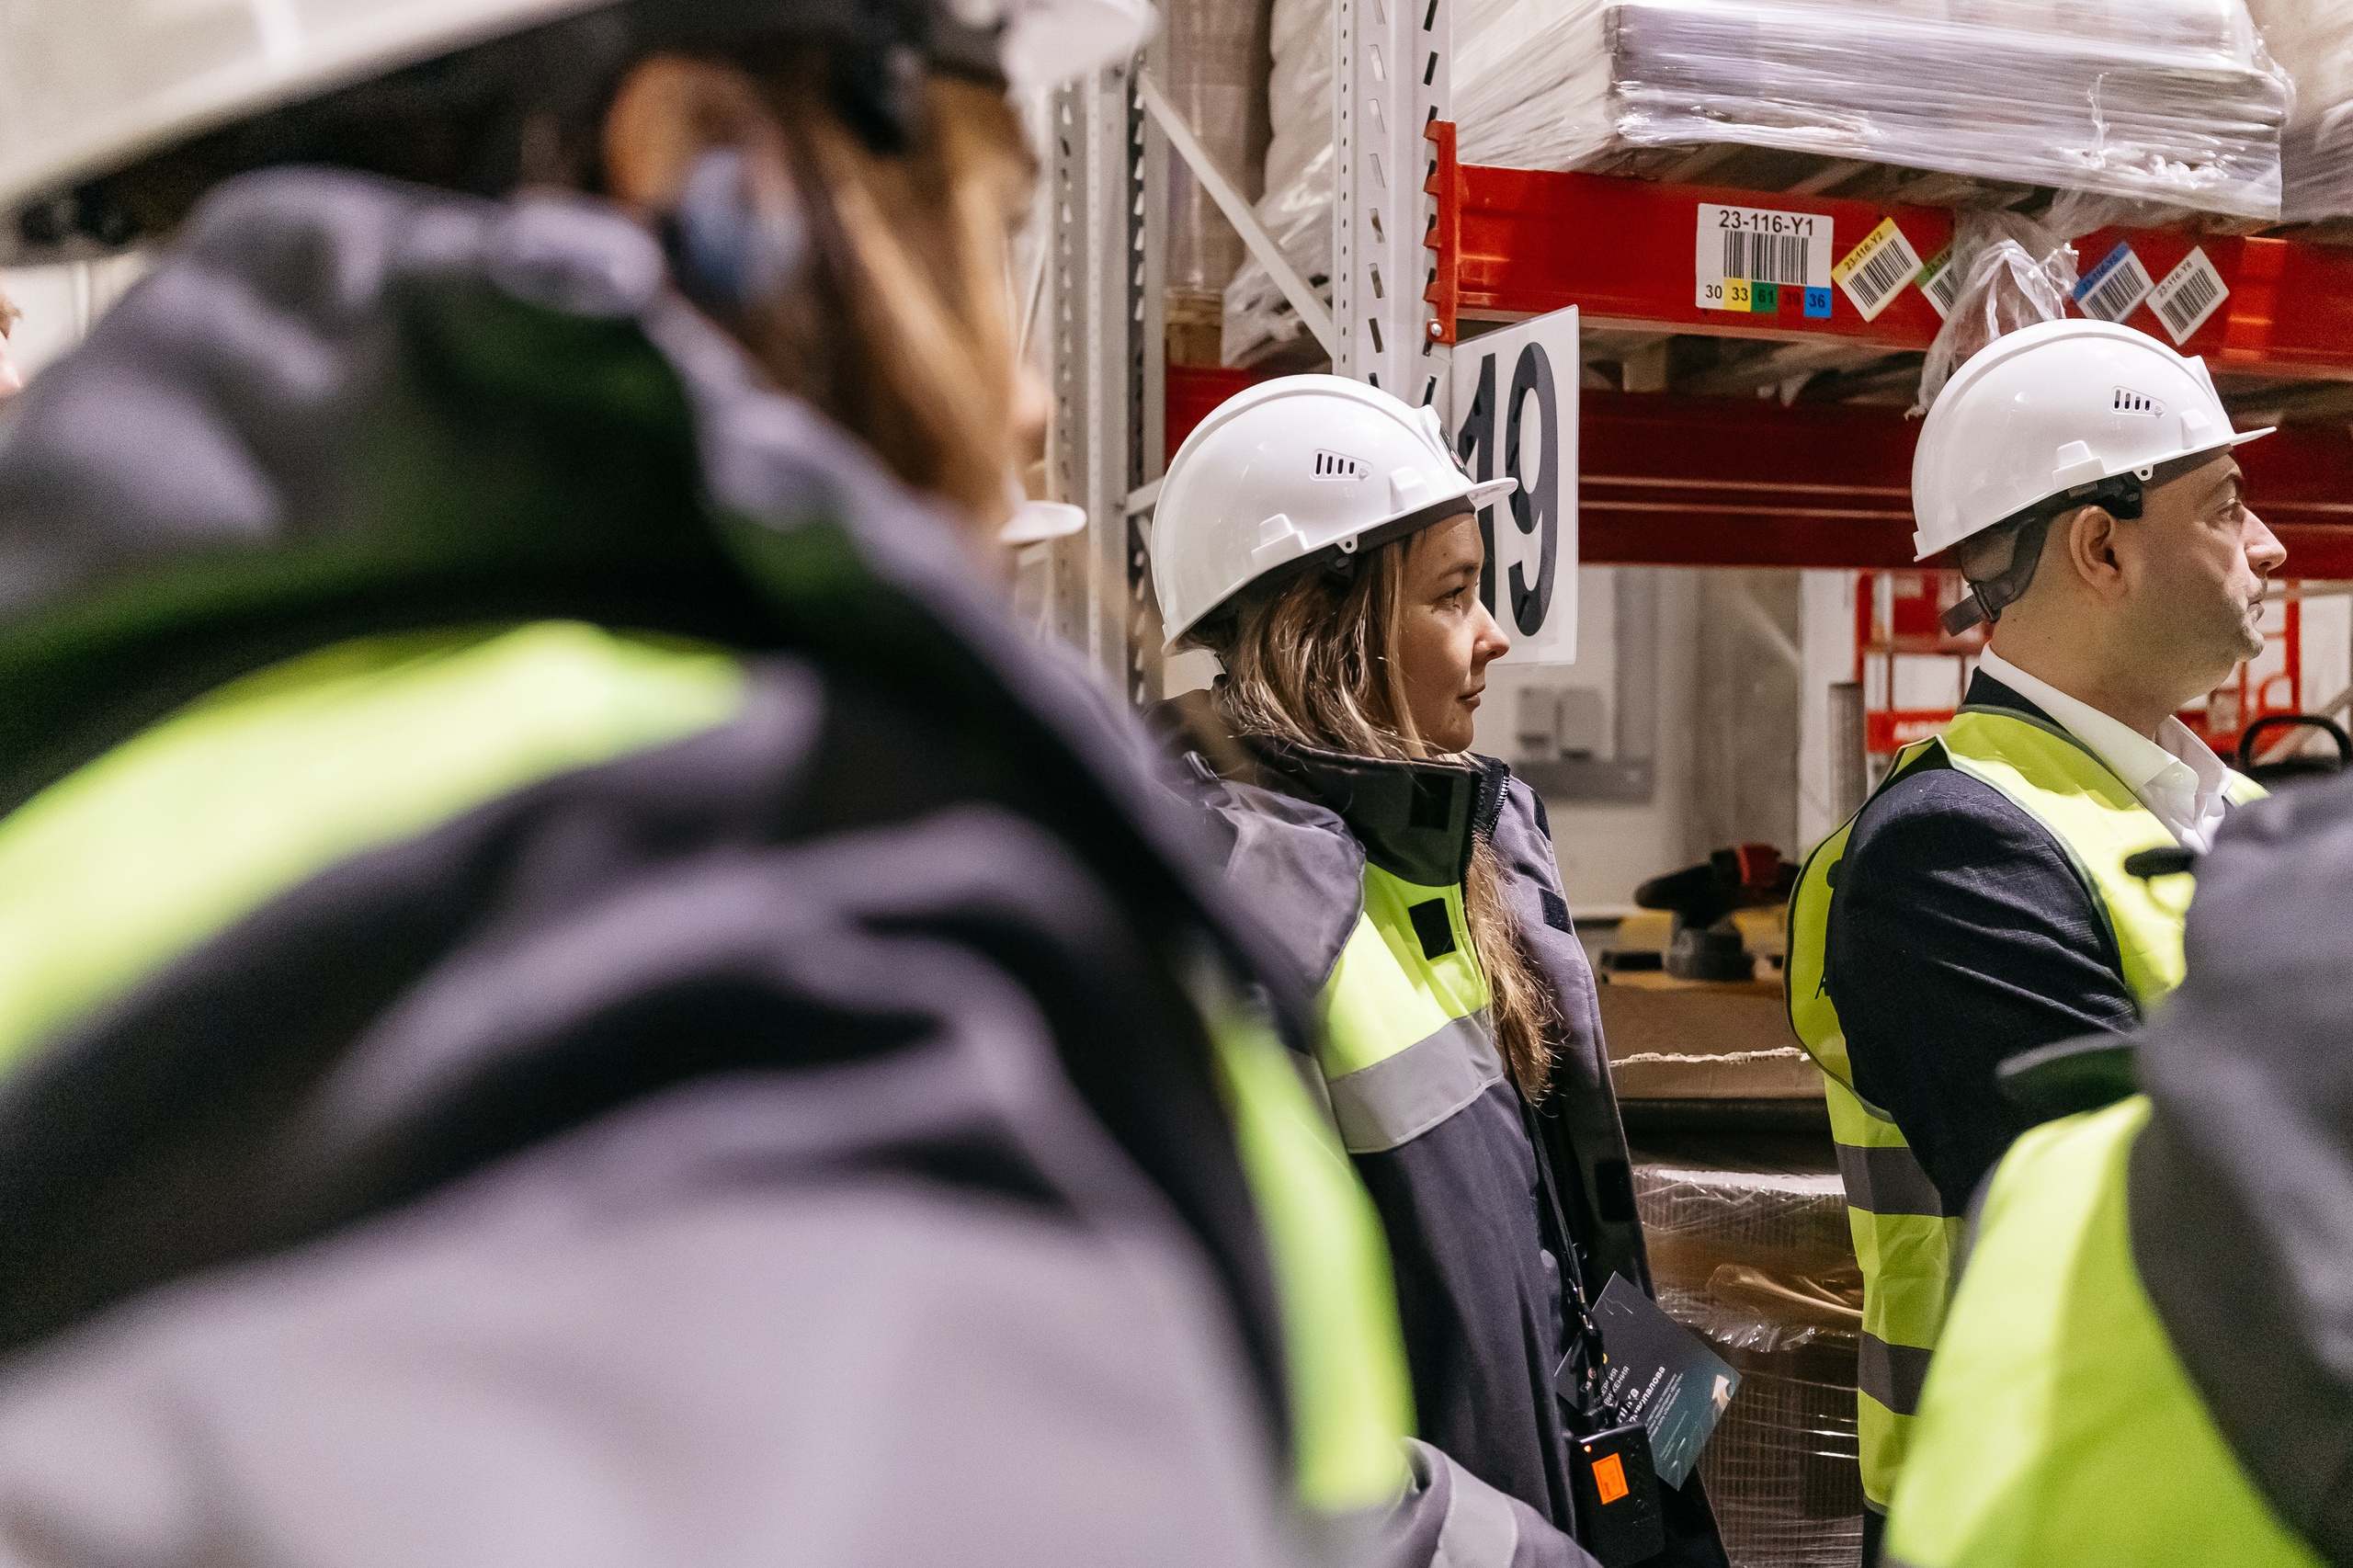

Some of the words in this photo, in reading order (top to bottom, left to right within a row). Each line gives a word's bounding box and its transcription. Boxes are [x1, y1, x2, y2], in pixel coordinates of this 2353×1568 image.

[1719, 209, 1814, 236] 23-116-Y1
[1843, 230, 1884, 271] 23-116-Y2
[1704, 284, 1723, 300] 30
[1731, 286, 1749, 302] 33
[1756, 288, 1775, 305] 61
[1783, 290, 1802, 307] 39
[1808, 292, 1826, 309] 36
[1457, 340, 1559, 637] 19
